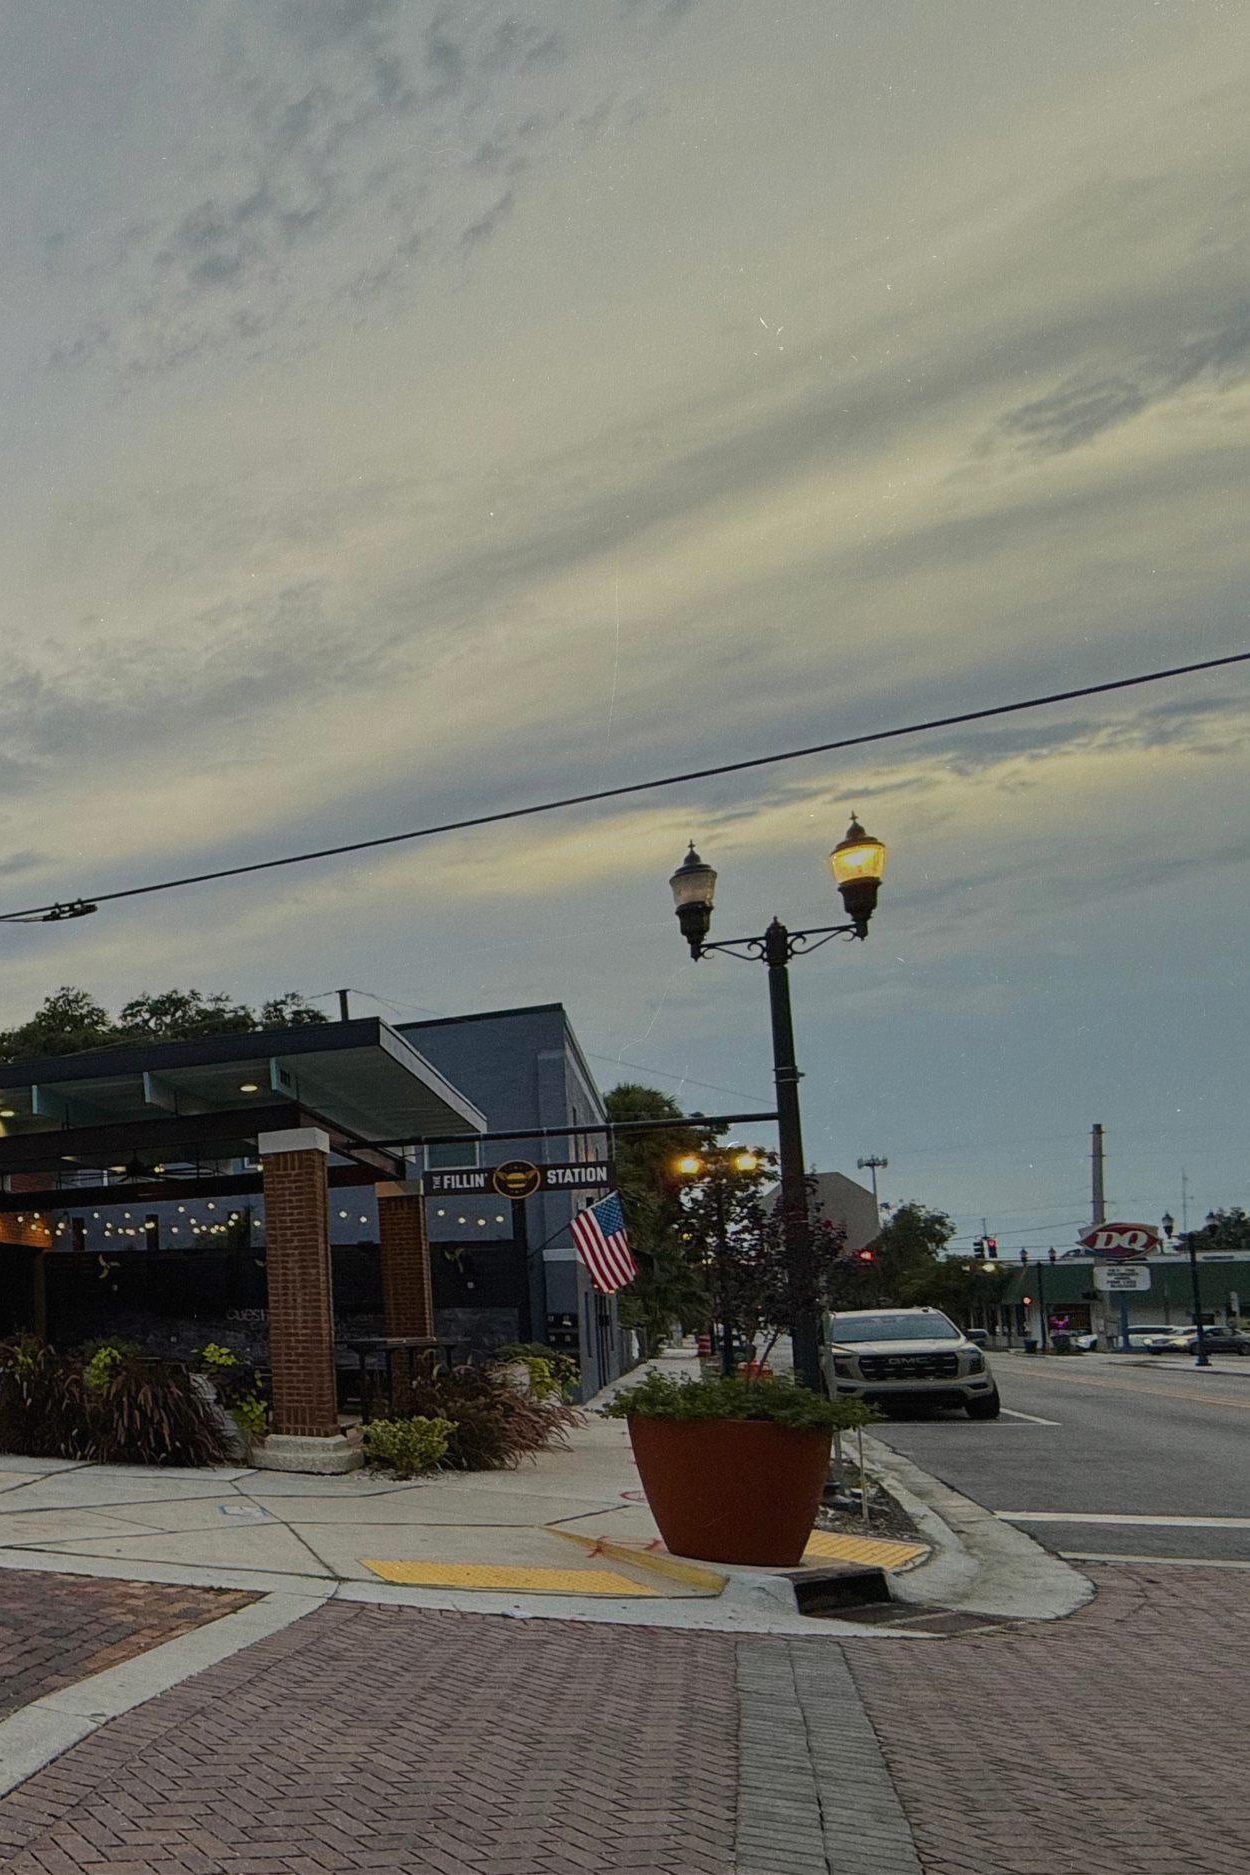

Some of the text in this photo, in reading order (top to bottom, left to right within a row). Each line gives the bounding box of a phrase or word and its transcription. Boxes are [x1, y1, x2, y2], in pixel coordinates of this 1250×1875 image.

[432, 1166, 608, 1189] THE FILLIN' STATION
[1093, 1230, 1148, 1250] DQ
[888, 1356, 930, 1365] GMC
